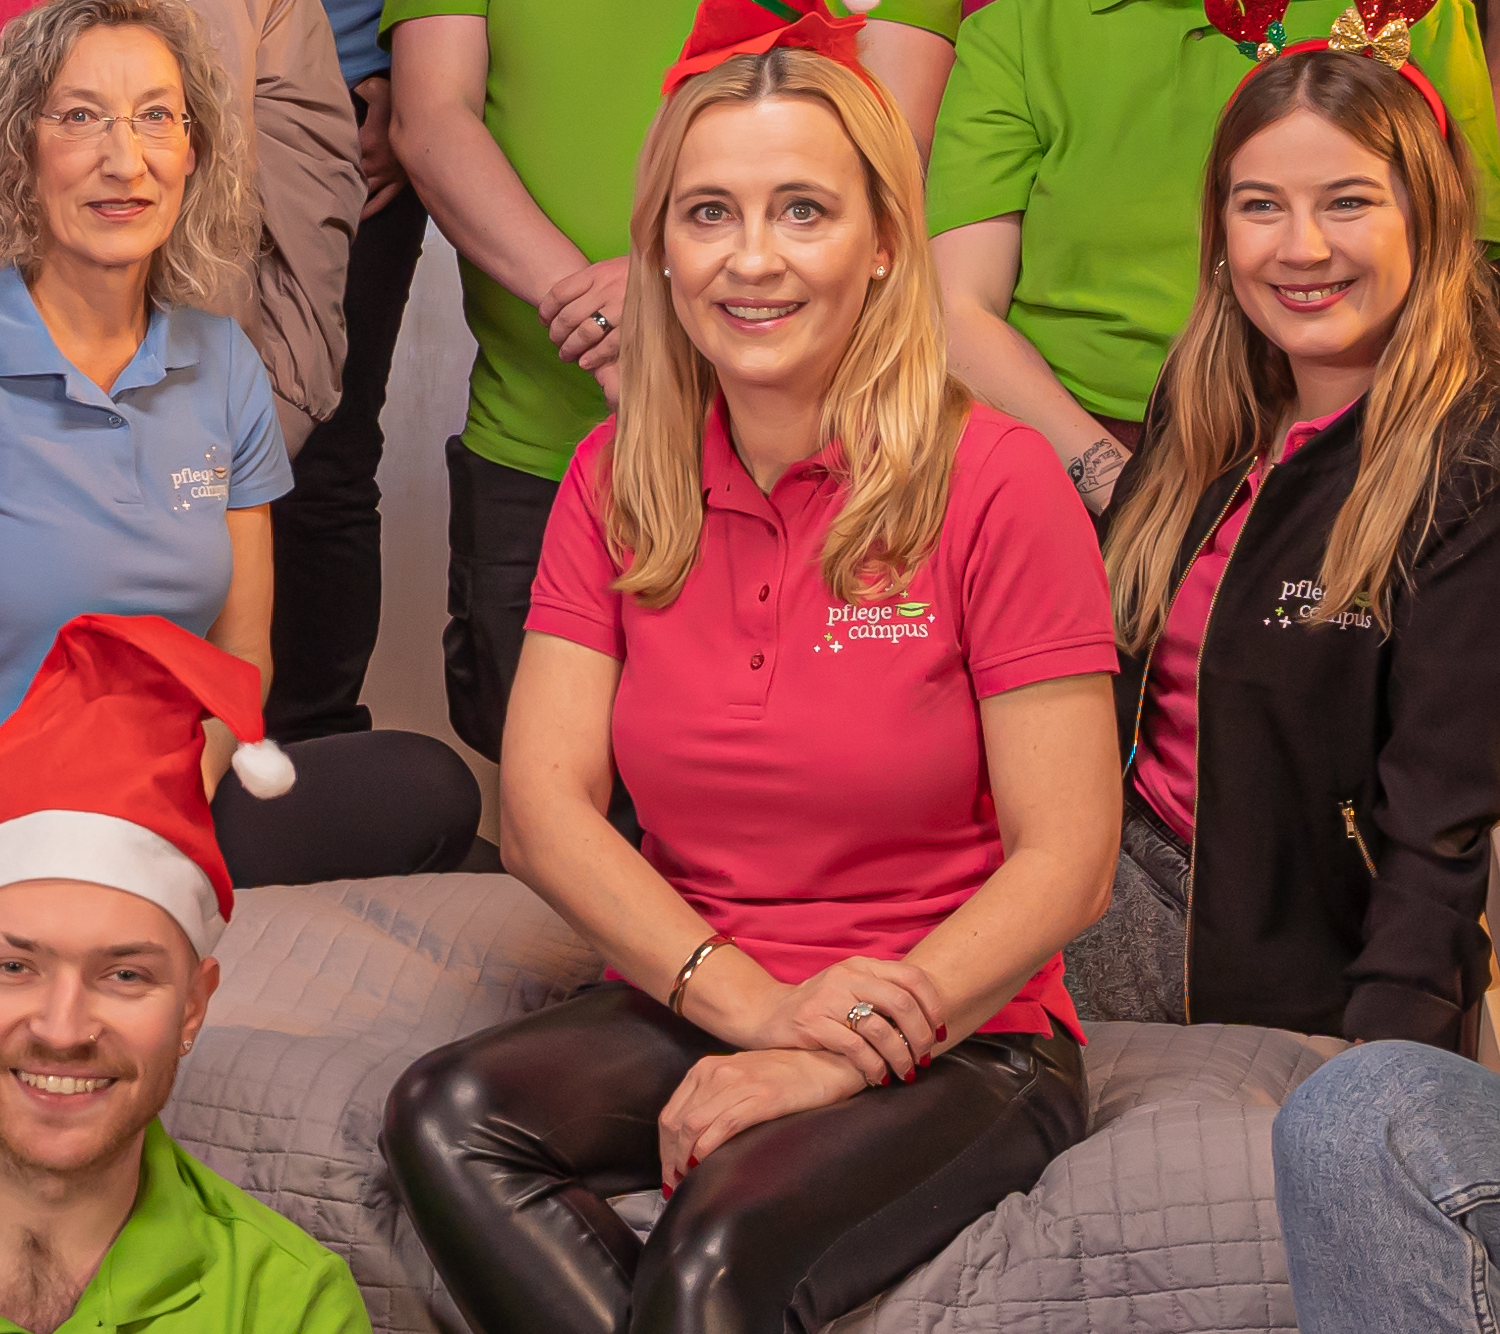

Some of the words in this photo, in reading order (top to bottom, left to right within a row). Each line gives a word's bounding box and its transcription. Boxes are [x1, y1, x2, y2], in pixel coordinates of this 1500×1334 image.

[1278, 579, 1327, 601] pfle
[825, 603, 892, 626] pflege
[848, 623, 929, 644] campus
